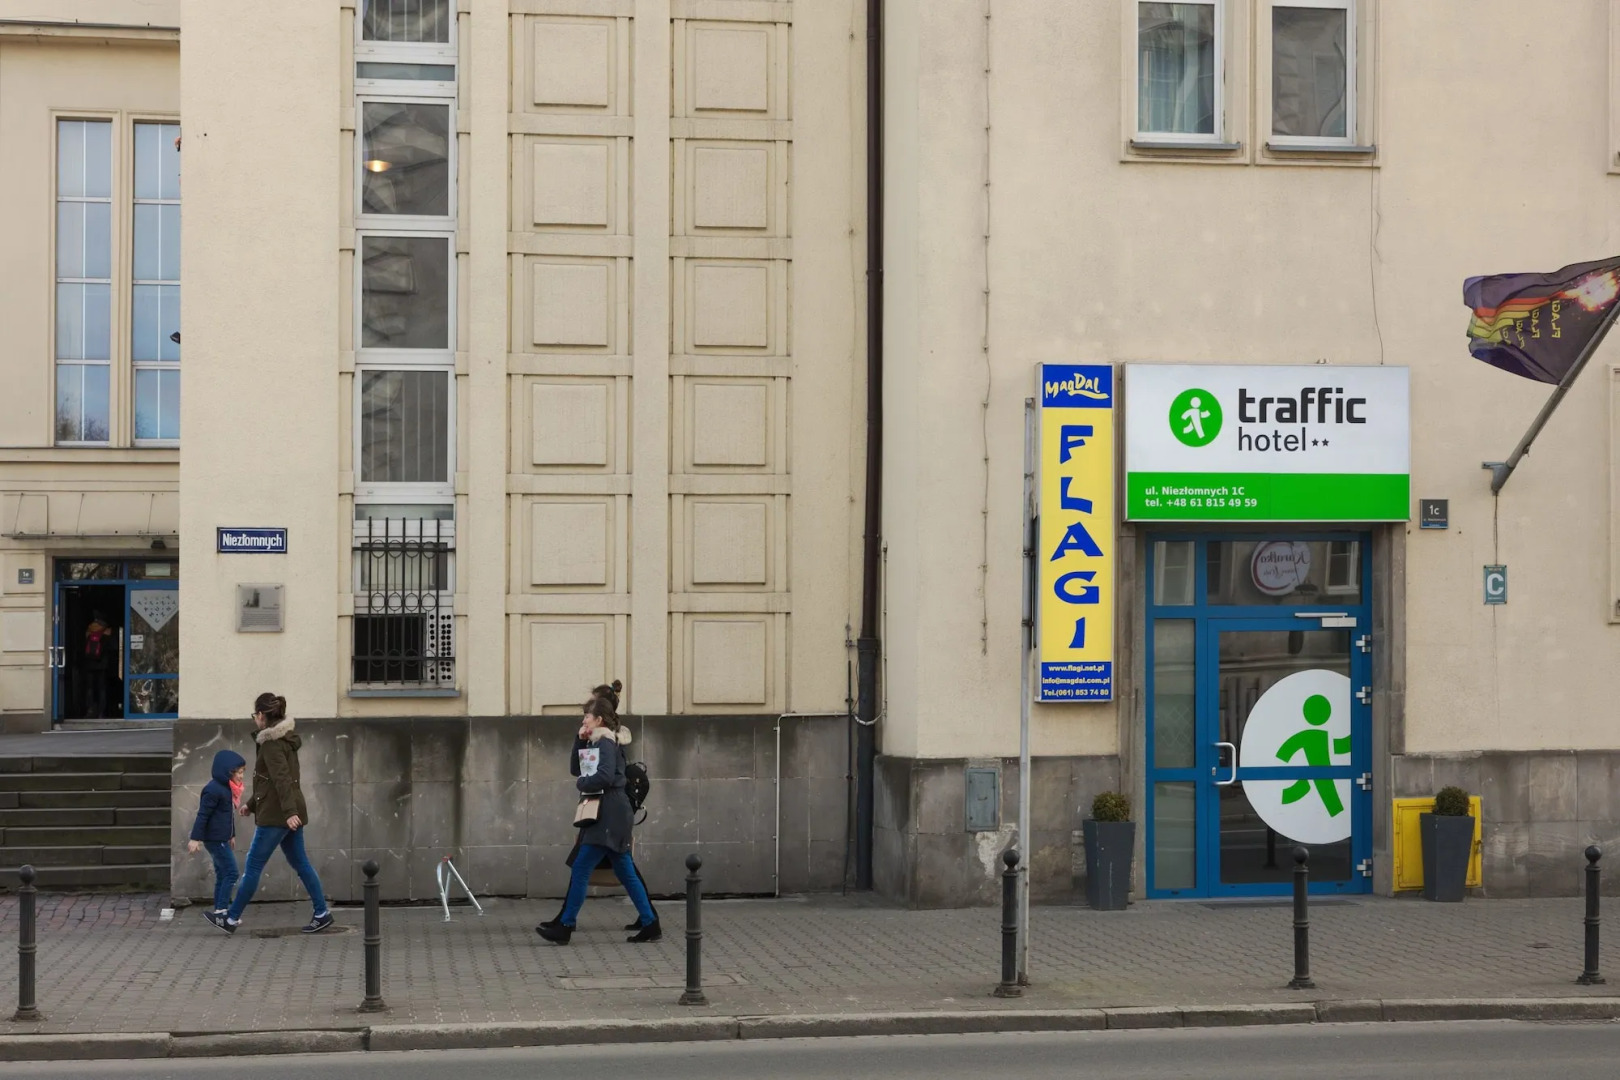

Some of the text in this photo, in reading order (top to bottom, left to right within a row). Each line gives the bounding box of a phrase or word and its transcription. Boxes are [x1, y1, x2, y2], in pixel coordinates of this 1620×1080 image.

[1238, 387, 1367, 424] traffic
[1238, 427, 1306, 451] hotel
[1145, 486, 1245, 498] ul. Niezłomnych 1C
[1145, 498, 1257, 507] tel. +48 61 815 49 59
[1429, 504, 1440, 515] 1c
[222, 533, 283, 550] Niezłomnych
[1050, 425, 1104, 649] FLAGI
[1487, 573, 1504, 595] C
[1042, 677, 1110, 685] info@magdal.com.pl
[1043, 689, 1074, 697] Tel.(061)
